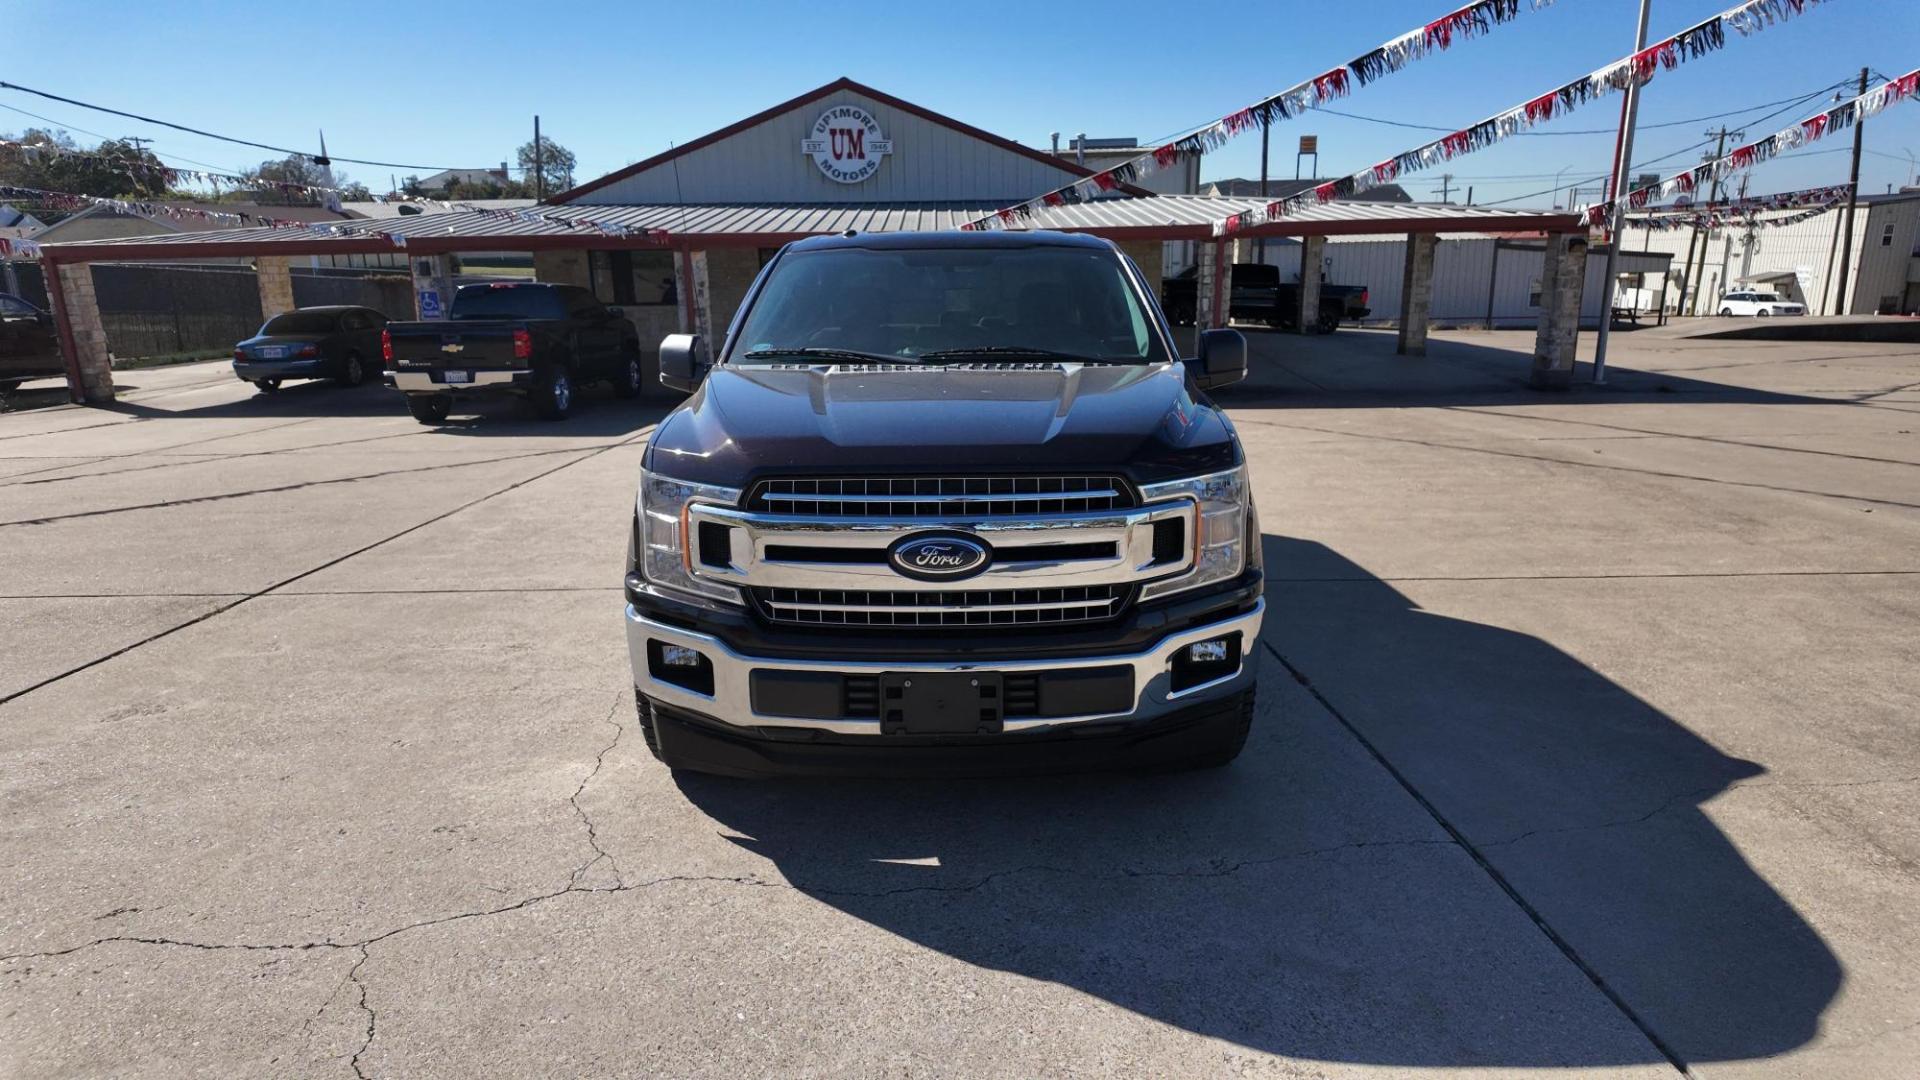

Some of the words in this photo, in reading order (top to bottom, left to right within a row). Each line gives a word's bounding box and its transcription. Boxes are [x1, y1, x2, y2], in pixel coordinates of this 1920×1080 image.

[816, 108, 877, 134] UPTMORE
[829, 128, 865, 160] UM
[820, 159, 876, 181] MOTORS
[916, 545, 963, 566] Ford
